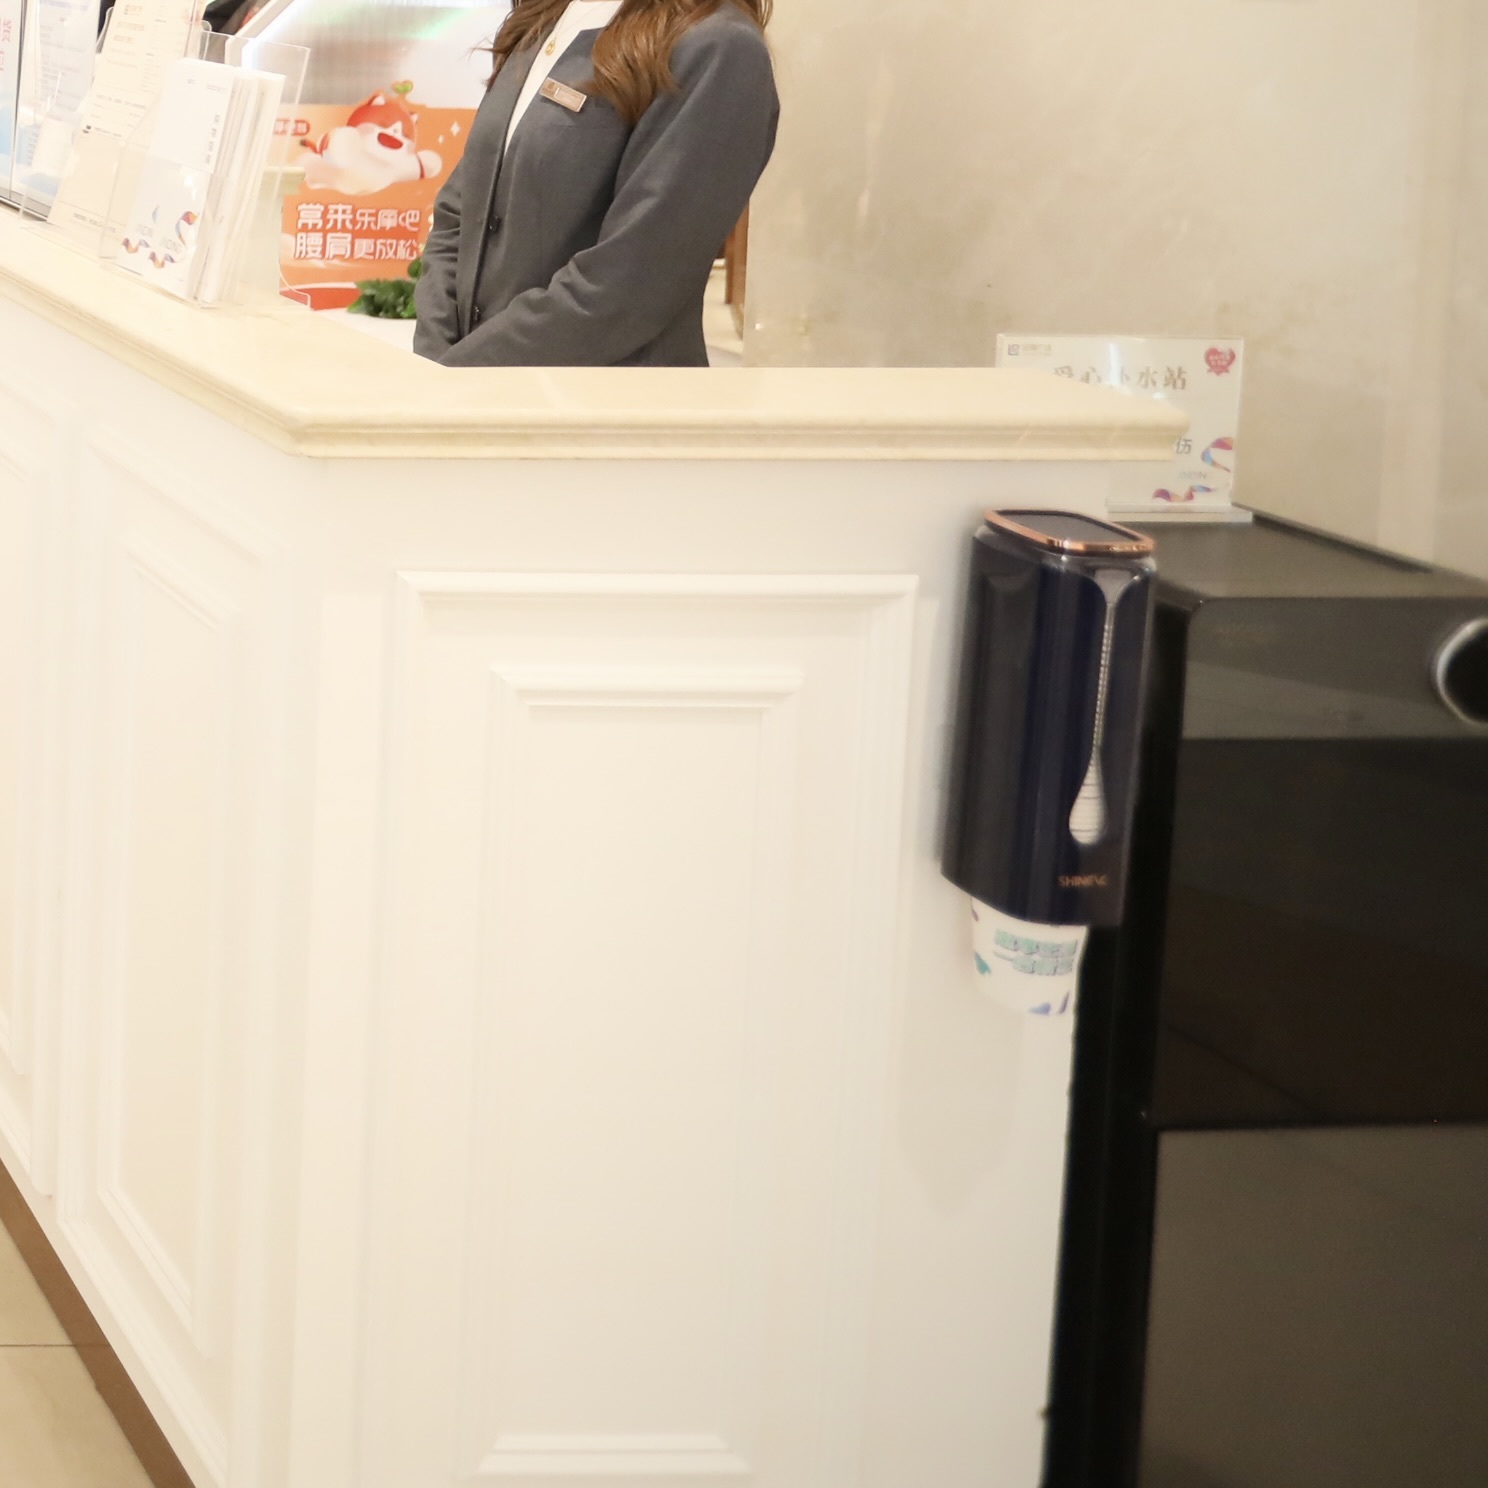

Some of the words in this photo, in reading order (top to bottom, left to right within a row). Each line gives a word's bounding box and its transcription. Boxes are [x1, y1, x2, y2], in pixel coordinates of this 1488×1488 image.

[297, 202, 421, 232] 常来乐摩吧
[294, 231, 419, 261] 腰肩更放松
